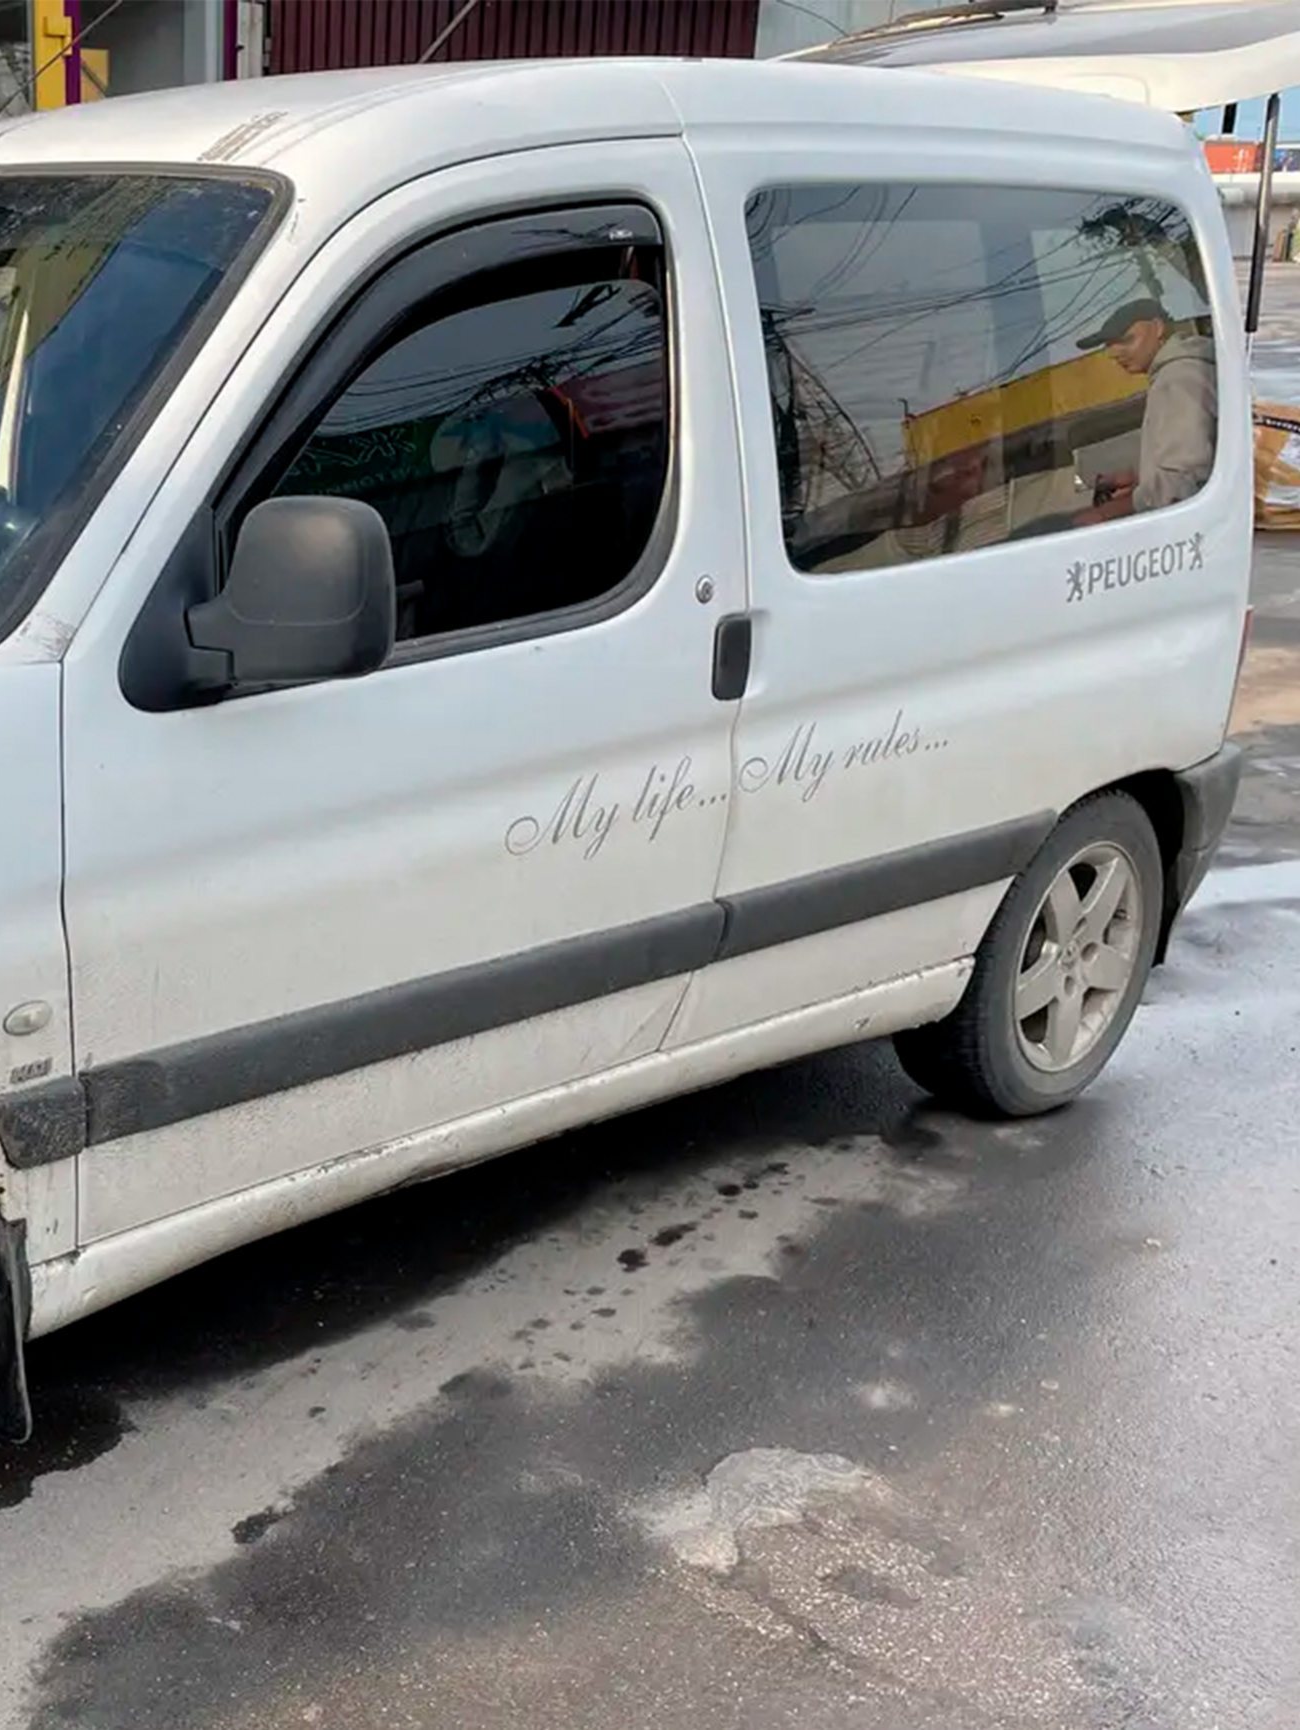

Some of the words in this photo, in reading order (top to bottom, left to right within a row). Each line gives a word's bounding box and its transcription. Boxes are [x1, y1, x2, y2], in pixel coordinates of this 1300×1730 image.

[1087, 540, 1187, 594] PEUGEOT
[504, 772, 620, 860] My
[632, 756, 727, 841] life...
[738, 721, 835, 803] My
[843, 709, 949, 769] rules...
